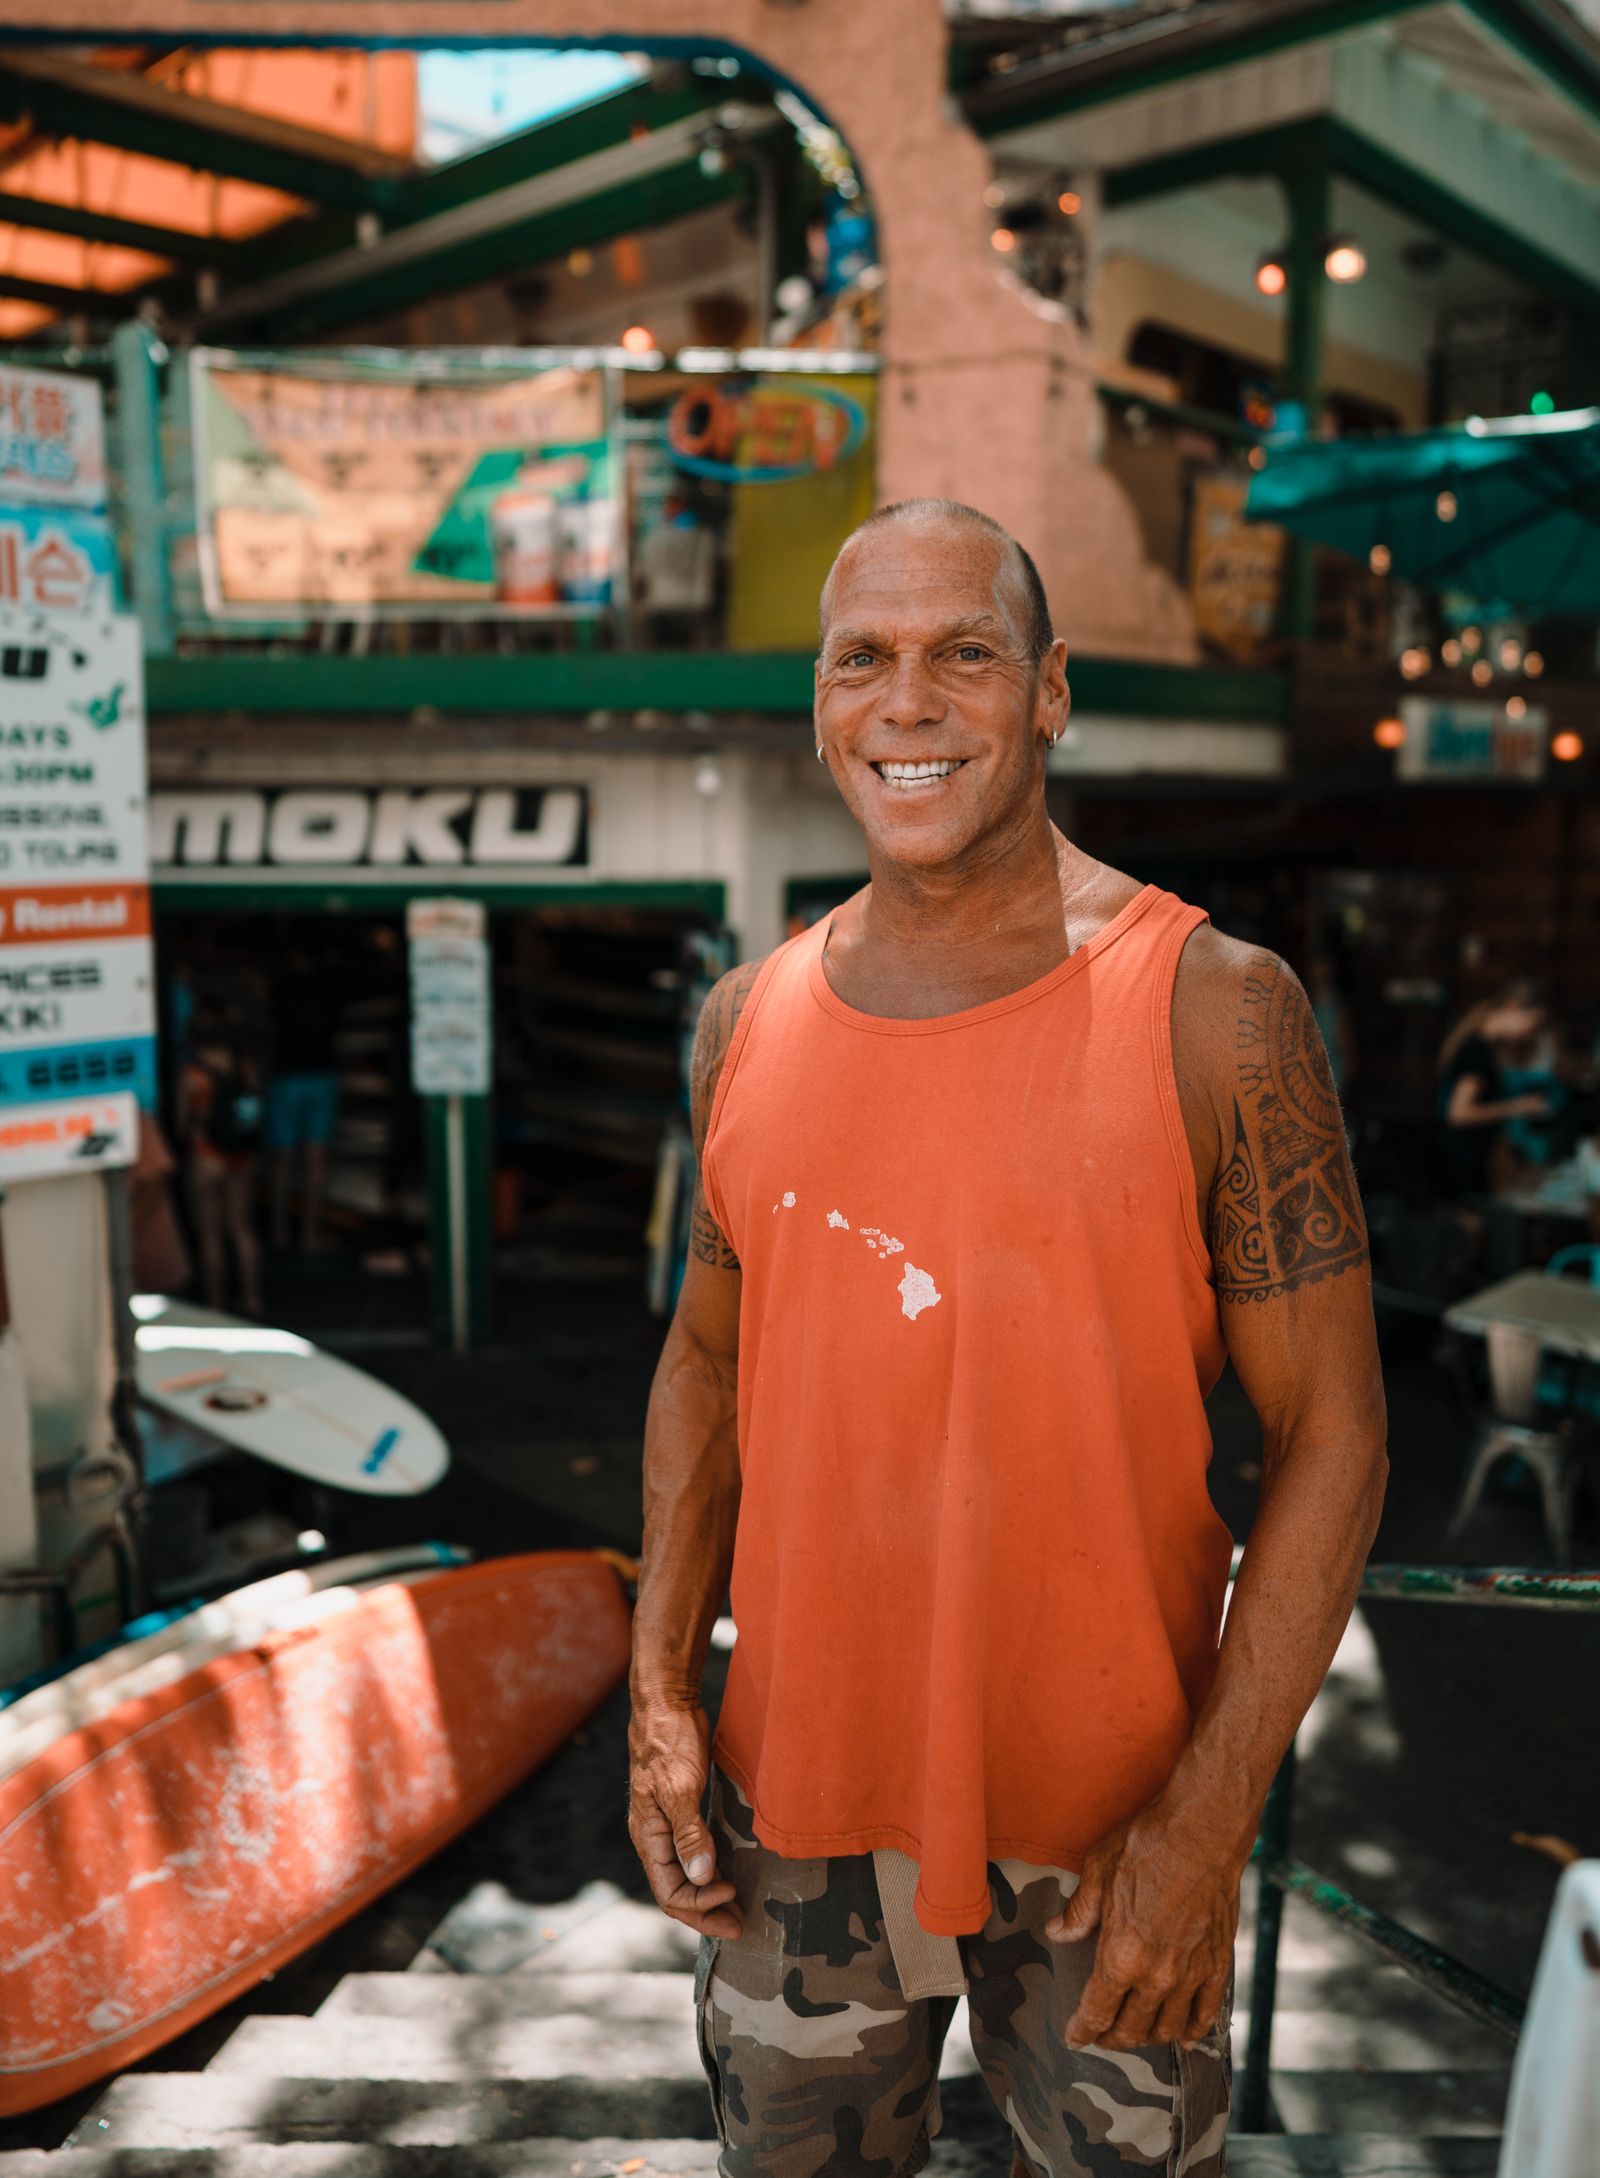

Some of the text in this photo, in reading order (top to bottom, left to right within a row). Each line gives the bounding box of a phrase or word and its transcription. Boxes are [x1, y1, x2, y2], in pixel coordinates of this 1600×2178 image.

[0, 726, 70, 748] AYS
[0, 760, 94, 786] 30PM
[150, 789, 582, 864] MOKU
[13, 893, 128, 933] Rental
